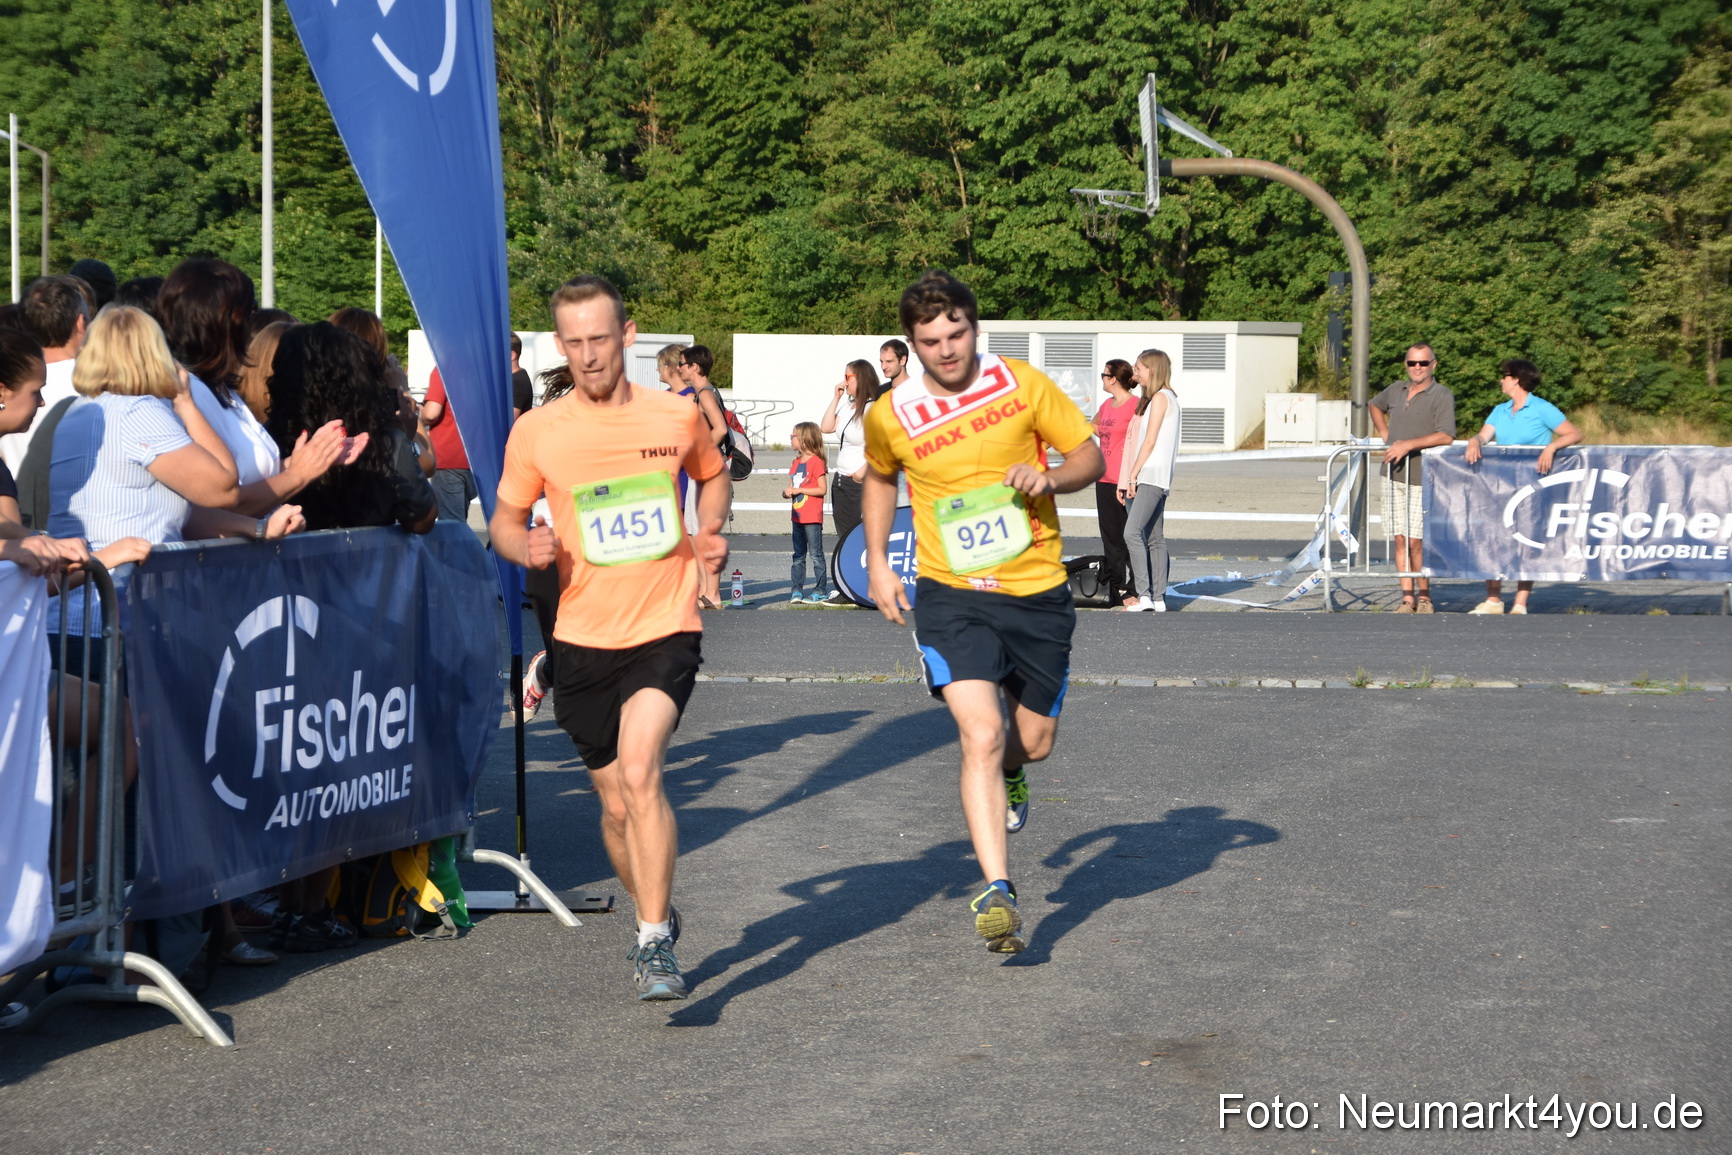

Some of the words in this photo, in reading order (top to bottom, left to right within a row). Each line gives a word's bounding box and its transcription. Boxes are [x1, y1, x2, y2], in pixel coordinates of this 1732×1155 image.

[913, 425, 967, 461] MAX
[970, 397, 1028, 433] BÖGL
[639, 446, 679, 459] THULE
[589, 506, 666, 544] 1451
[957, 514, 1010, 551] 921
[1546, 502, 1732, 539] Fischer
[1563, 543, 1730, 560] AUTOMOBILE
[264, 763, 413, 831] AUTOMOBILE
